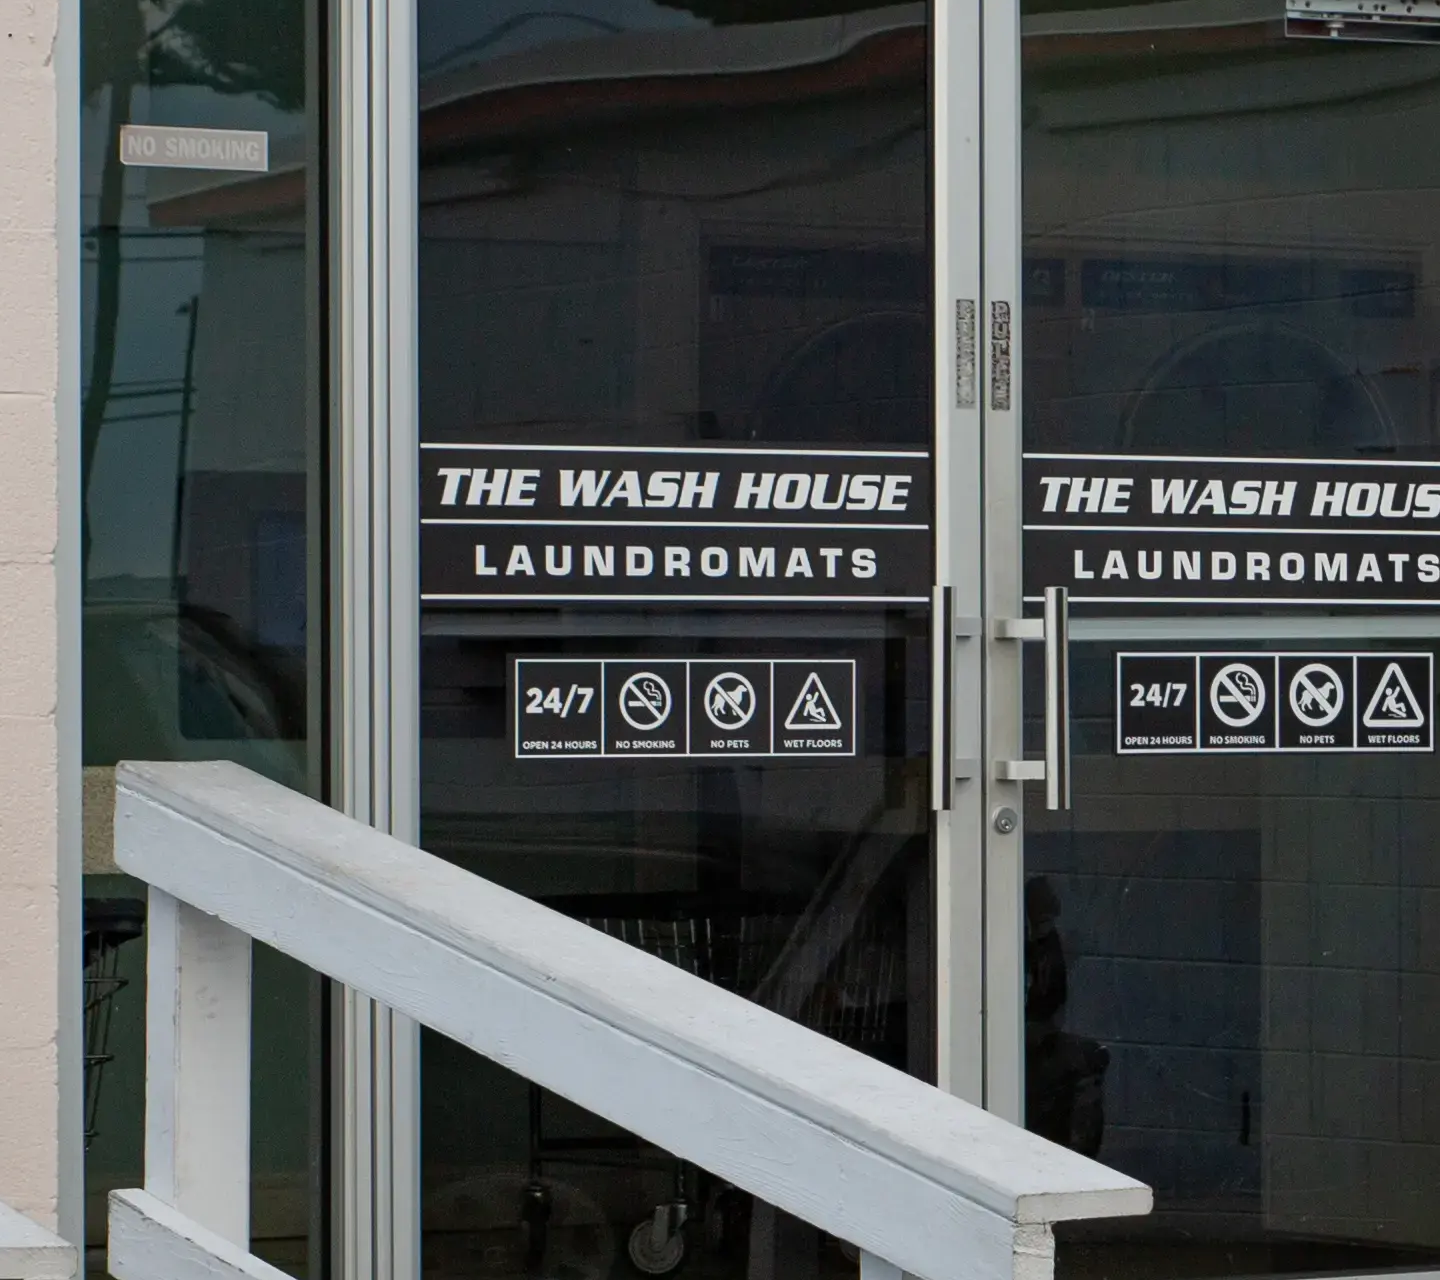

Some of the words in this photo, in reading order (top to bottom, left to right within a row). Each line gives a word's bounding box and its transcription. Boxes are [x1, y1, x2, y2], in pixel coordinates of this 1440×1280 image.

[127, 134, 157, 157] NO
[164, 136, 260, 162] SMOKING
[436, 467, 541, 506] THE
[559, 469, 721, 509] WASH
[733, 472, 913, 512] HOUSE
[1039, 476, 1134, 514] THE
[1150, 478, 1298, 516] WASH
[474, 544, 878, 579] LAUNDROMATS
[1129, 682, 1188, 708] 24/7
[525, 683, 595, 719] 24/7
[615, 740, 631, 749] NO
[631, 739, 676, 750] SMOKING
[710, 739, 726, 749] NO
[726, 739, 750, 749] PETS
[783, 739, 805, 749] WET
[805, 738, 843, 749] FLOORS
[1124, 736, 1149, 746] OPEN
[1149, 736, 1162, 745] 24
[1161, 735, 1193, 745] HOURS
[1209, 735, 1224, 745] NO
[1224, 735, 1266, 745] SMOKING
[1299, 735, 1314, 744] NO
[1313, 734, 1335, 744] PETS
[1367, 734, 1387, 744] WET
[1387, 734, 1421, 744] FLOORS
[522, 740, 550, 750] OPEN
[550, 740, 563, 750] 24
[564, 740, 598, 750] HOURS
